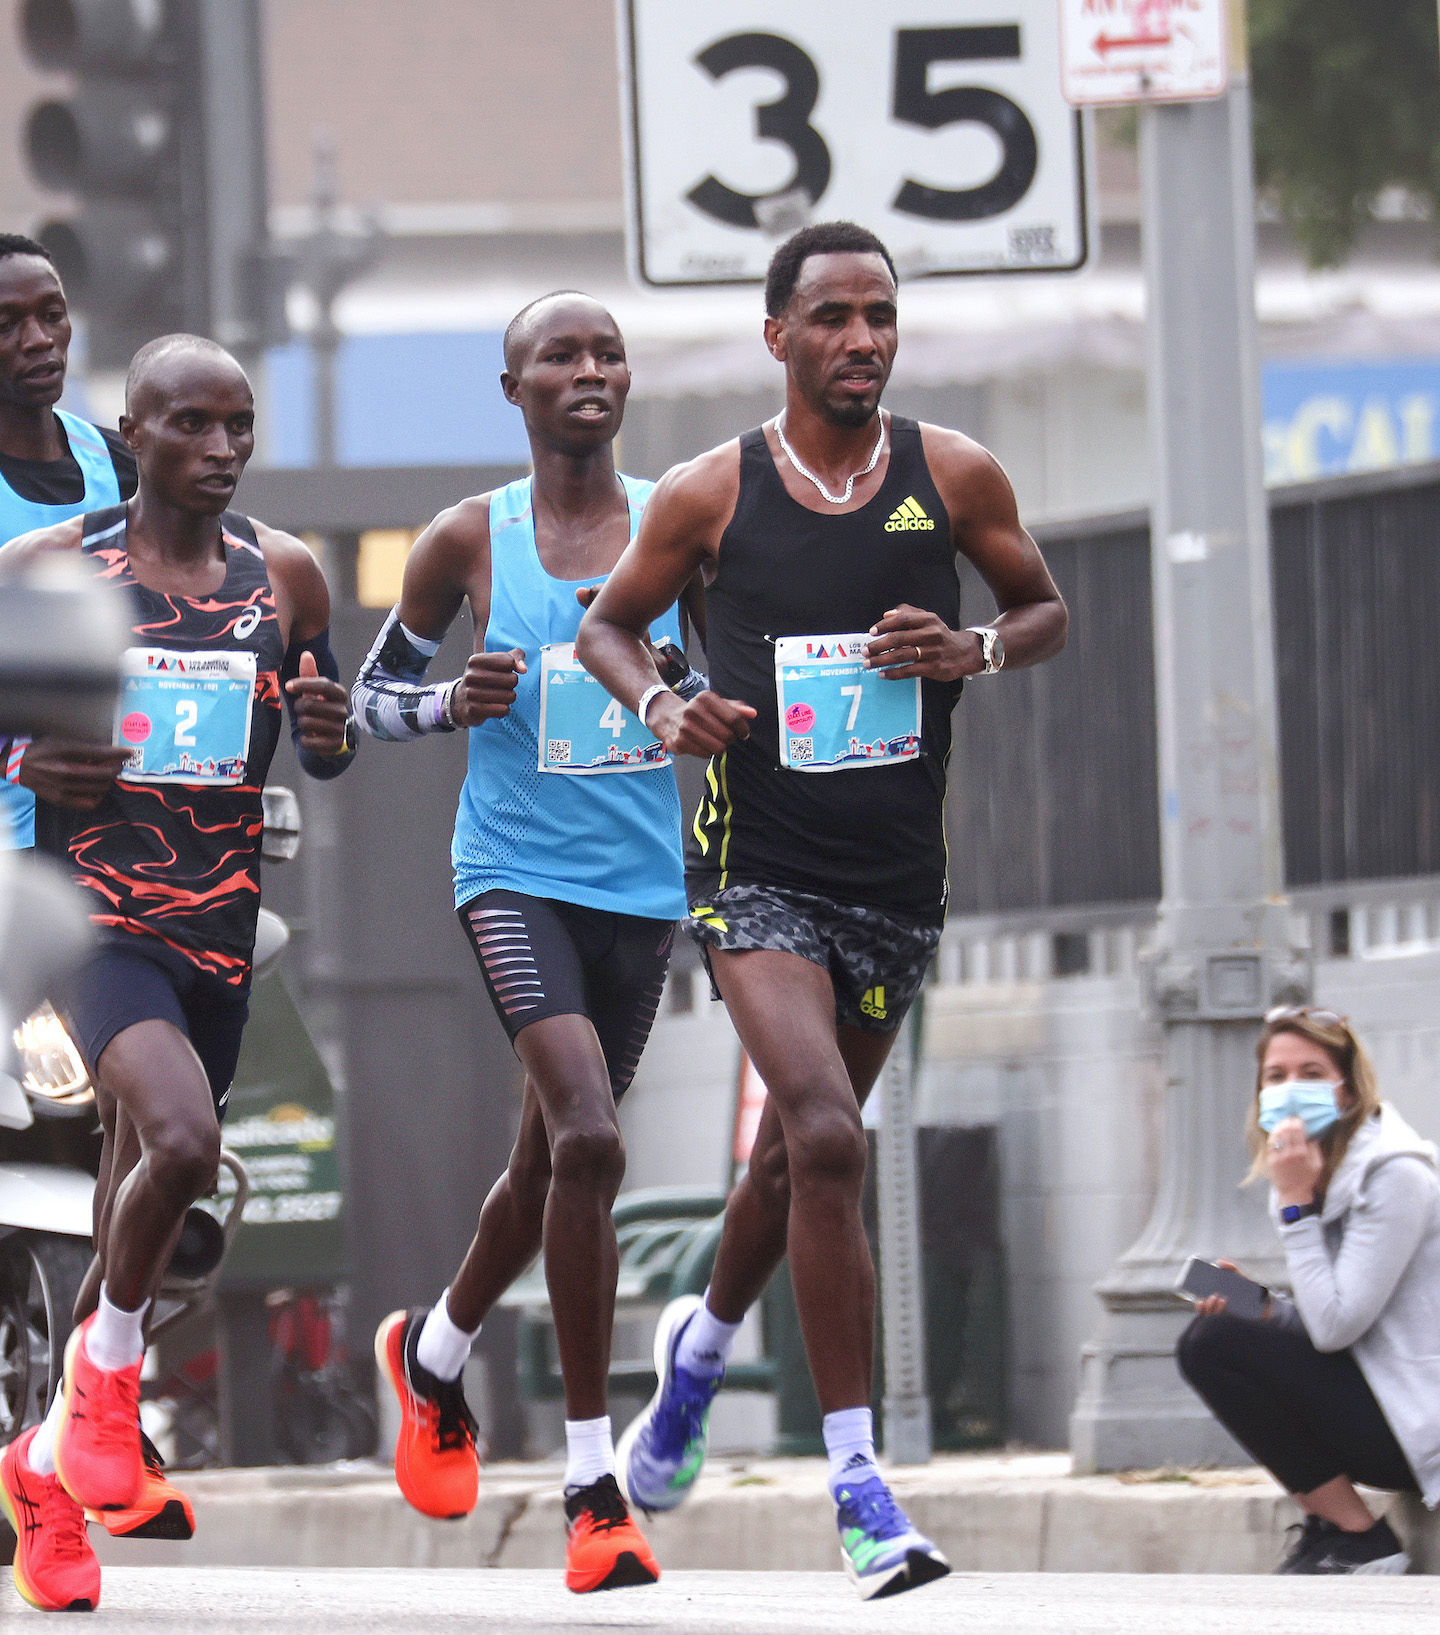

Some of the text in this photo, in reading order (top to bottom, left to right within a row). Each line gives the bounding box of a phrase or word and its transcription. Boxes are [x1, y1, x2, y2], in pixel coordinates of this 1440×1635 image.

[686, 25, 1038, 229] 35
[884, 517, 935, 532] adidas
[158, 681, 195, 690] NOVEMBER
[820, 668, 858, 676] NOVEMBER
[174, 700, 198, 747] 2
[599, 697, 626, 738] 4
[841, 685, 862, 731] 7
